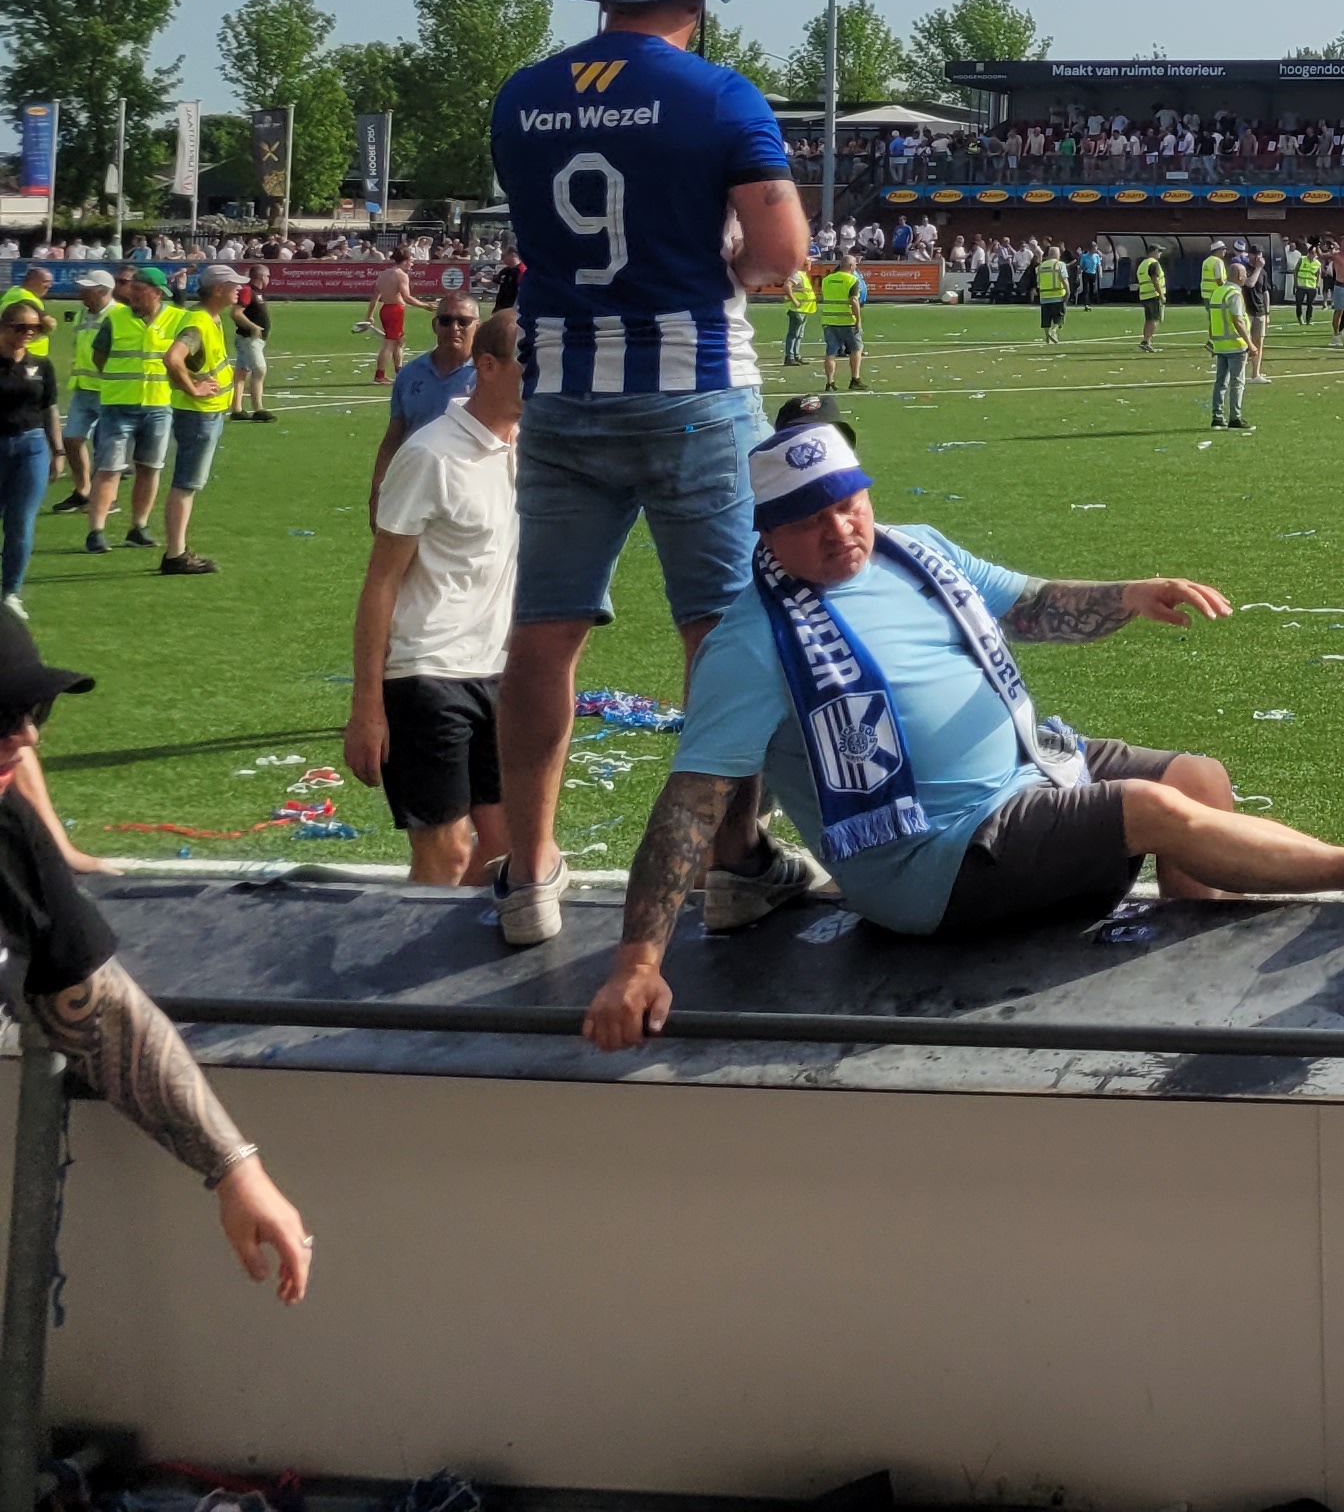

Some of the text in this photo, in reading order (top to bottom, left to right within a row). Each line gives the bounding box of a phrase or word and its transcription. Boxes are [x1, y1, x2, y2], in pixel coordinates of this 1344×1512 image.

[1052, 64, 1227, 76] Maakt van ruimte interieur.
[520, 100, 660, 132] Van Wezel
[553, 152, 629, 285] 9
